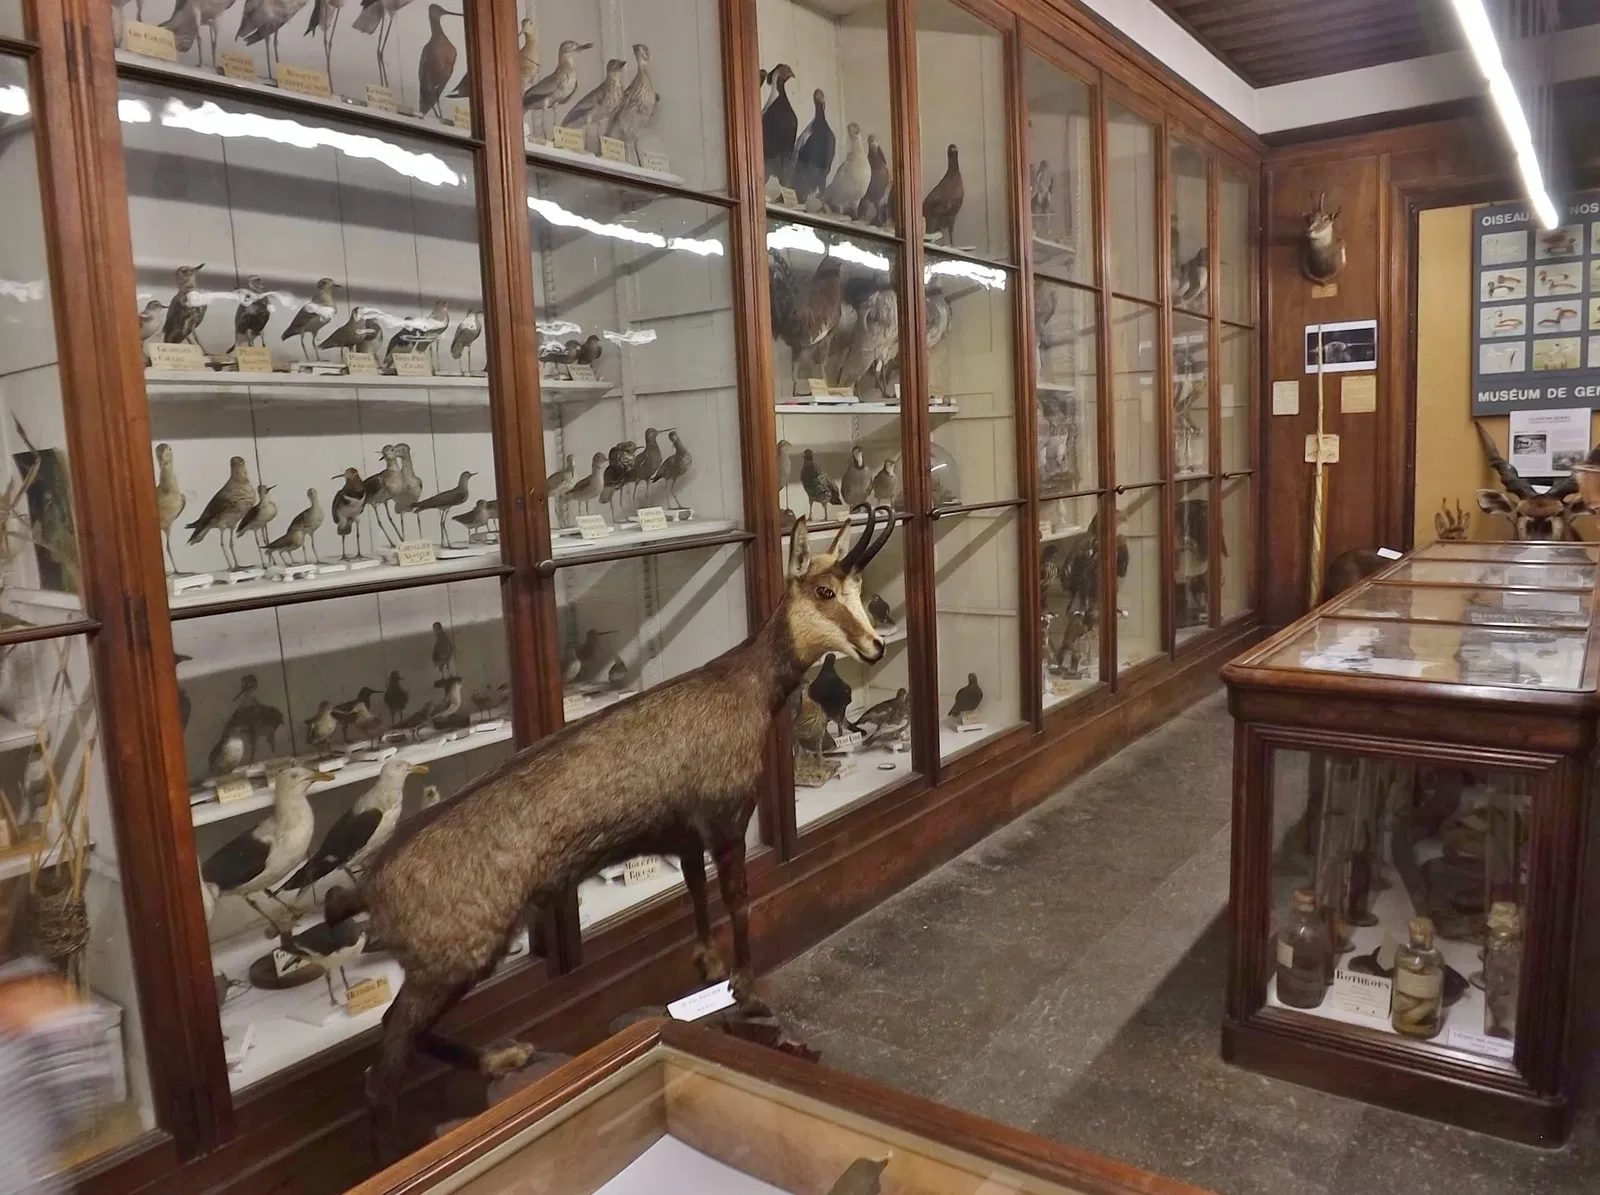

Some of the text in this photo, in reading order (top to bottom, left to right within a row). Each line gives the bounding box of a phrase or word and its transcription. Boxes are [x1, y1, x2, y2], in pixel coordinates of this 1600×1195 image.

[1481, 210, 1534, 227] OISEAU
[1478, 387, 1541, 403] MUSÉUM
[1547, 387, 1567, 399] DE
